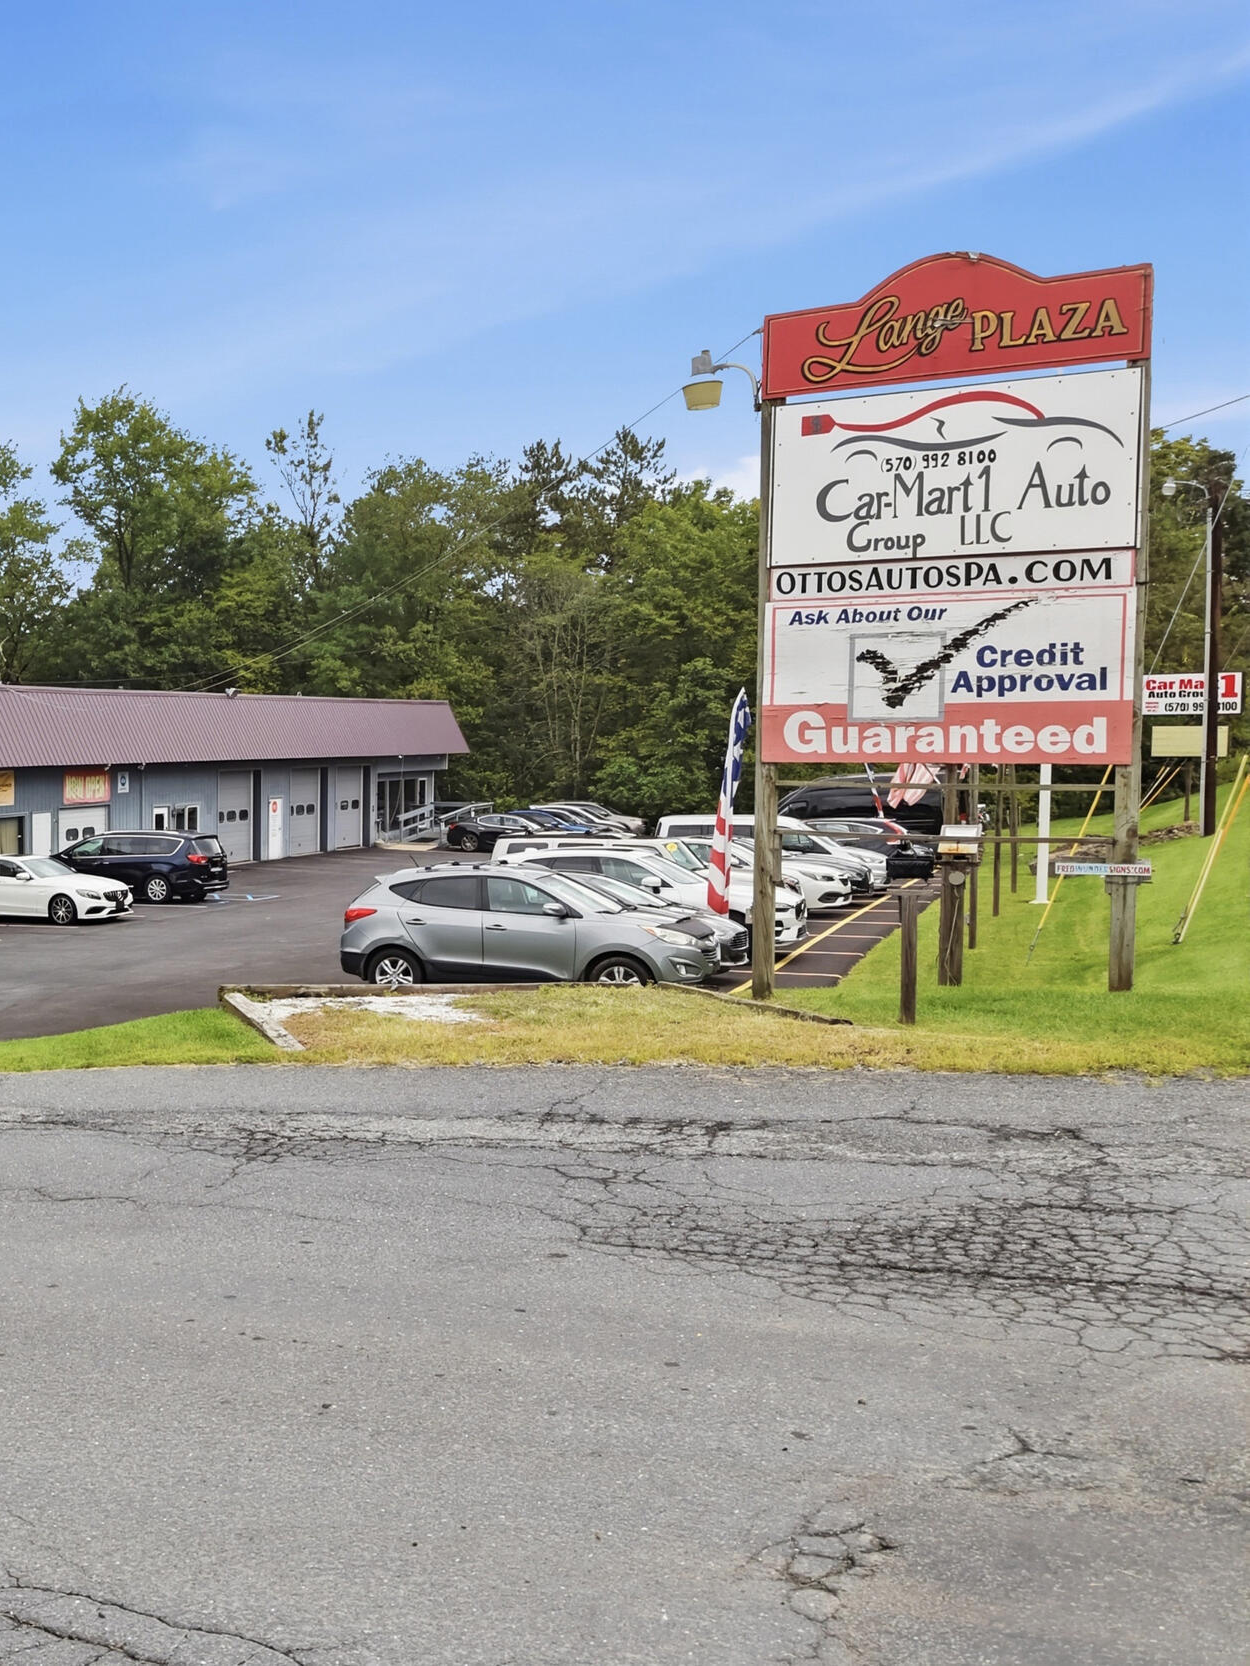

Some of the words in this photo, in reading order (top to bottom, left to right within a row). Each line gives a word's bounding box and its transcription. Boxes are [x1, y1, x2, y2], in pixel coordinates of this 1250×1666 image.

[801, 295, 969, 384] Lange
[969, 298, 1128, 352] PLAZA
[880, 456, 917, 473] (570)
[922, 452, 950, 469] 992
[957, 449, 997, 466] 8100
[1016, 461, 1112, 510] Auto
[846, 520, 926, 558] Group
[959, 511, 1013, 546] LLC
[788, 609, 830, 626] Ask
[836, 606, 902, 624] About
[906, 605, 948, 621] Our
[976, 642, 1085, 669] Credit
[950, 667, 1108, 698] Approval
[1145, 679, 1176, 691] Car
[1220, 673, 1239, 698] 1
[1148, 690, 1176, 698] Auto
[1178, 689, 1206, 698] Gro
[1164, 702, 1190, 712] (570)
[782, 710, 1108, 754] Guaranteed
